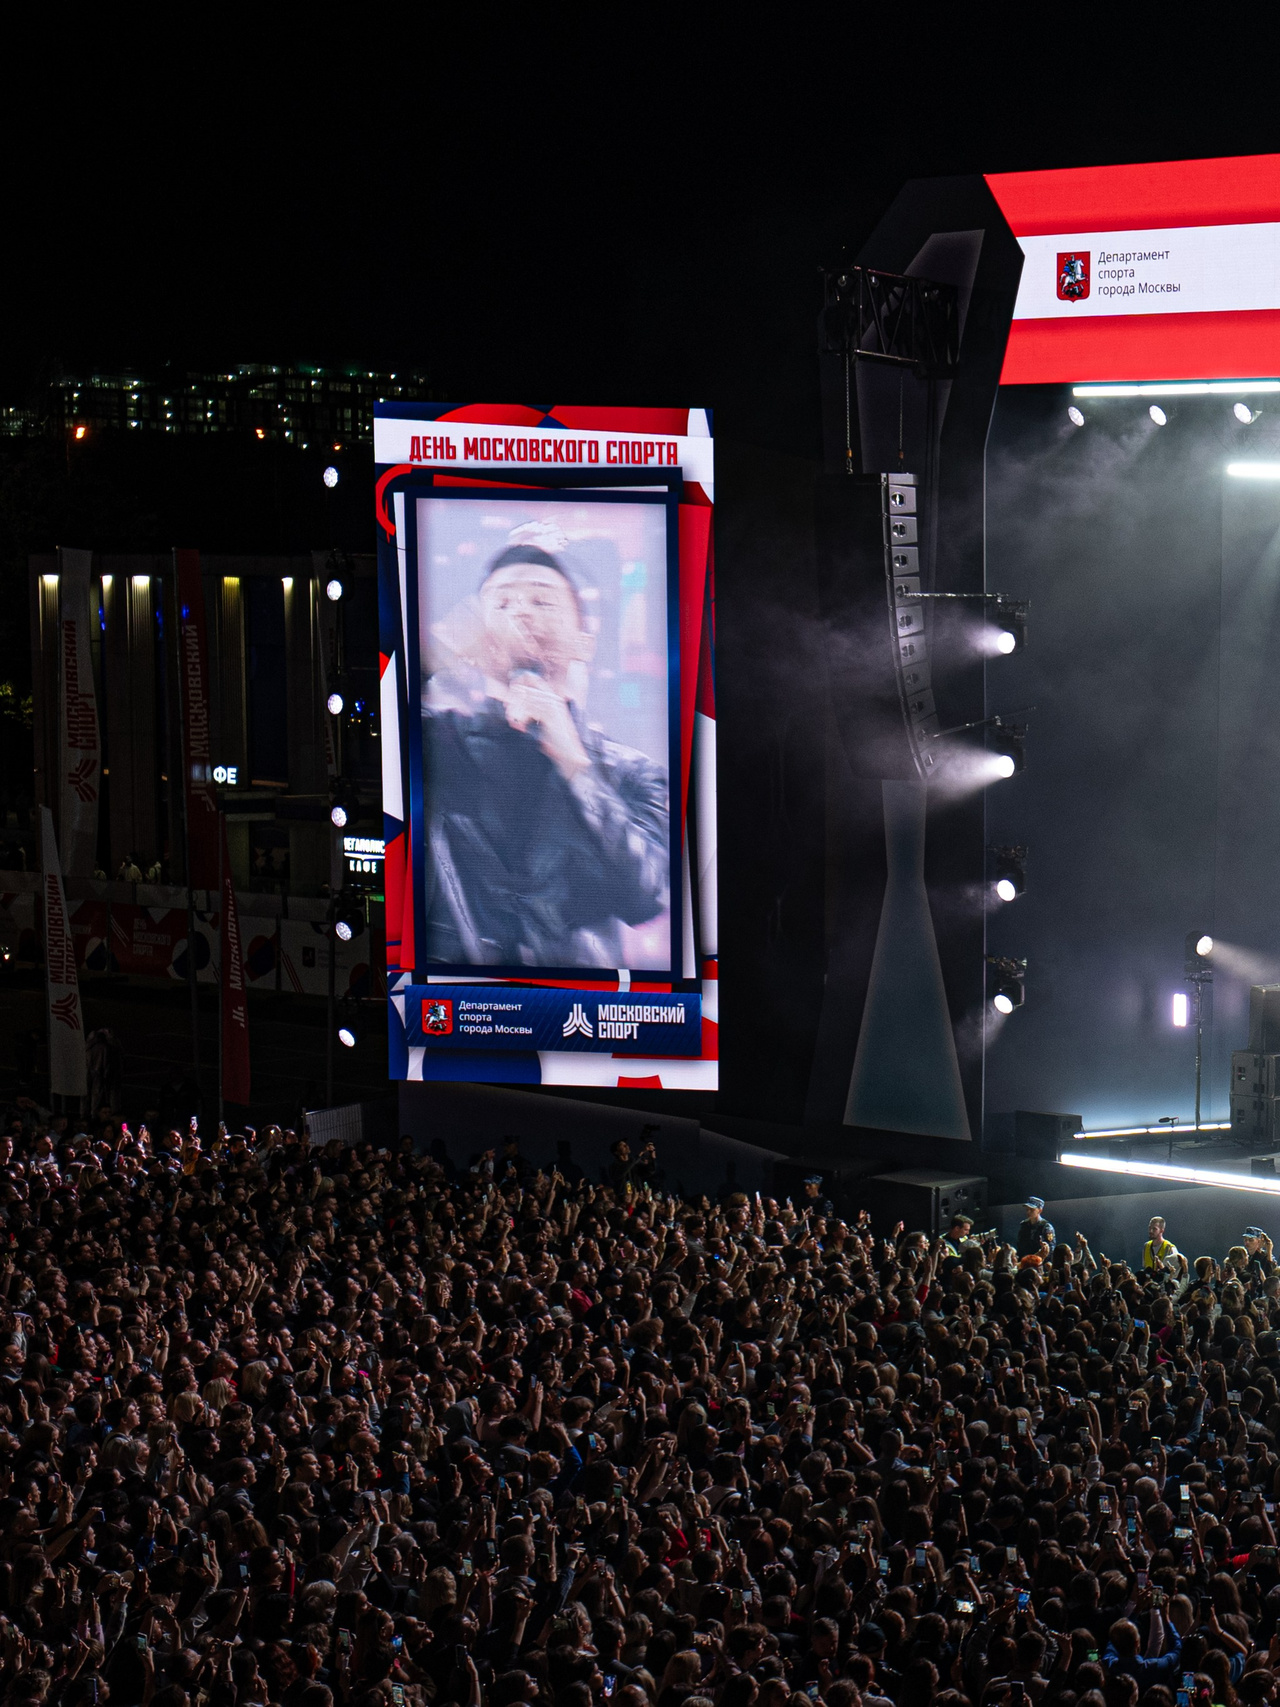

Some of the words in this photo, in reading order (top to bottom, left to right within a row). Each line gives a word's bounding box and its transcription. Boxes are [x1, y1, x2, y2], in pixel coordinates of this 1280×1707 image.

[1098, 250, 1170, 265] Департамент
[1098, 268, 1135, 281] спорта
[1098, 285, 1135, 298] города
[1138, 282, 1181, 294] Москвы
[409, 435, 457, 462] ДЕНЬ
[464, 436, 599, 464] МОСКОВСКОГО
[606, 440, 678, 466] СПОРТА
[349, 860, 377, 874] КАФЕ
[459, 1000, 522, 1012] Департамент
[459, 1013, 492, 1023] спорта
[598, 1003, 685, 1024] МОСКОВСКИЙ
[459, 1025, 493, 1035] города
[494, 1024, 533, 1035] Москвы
[598, 1022, 640, 1040] СПОРТ
